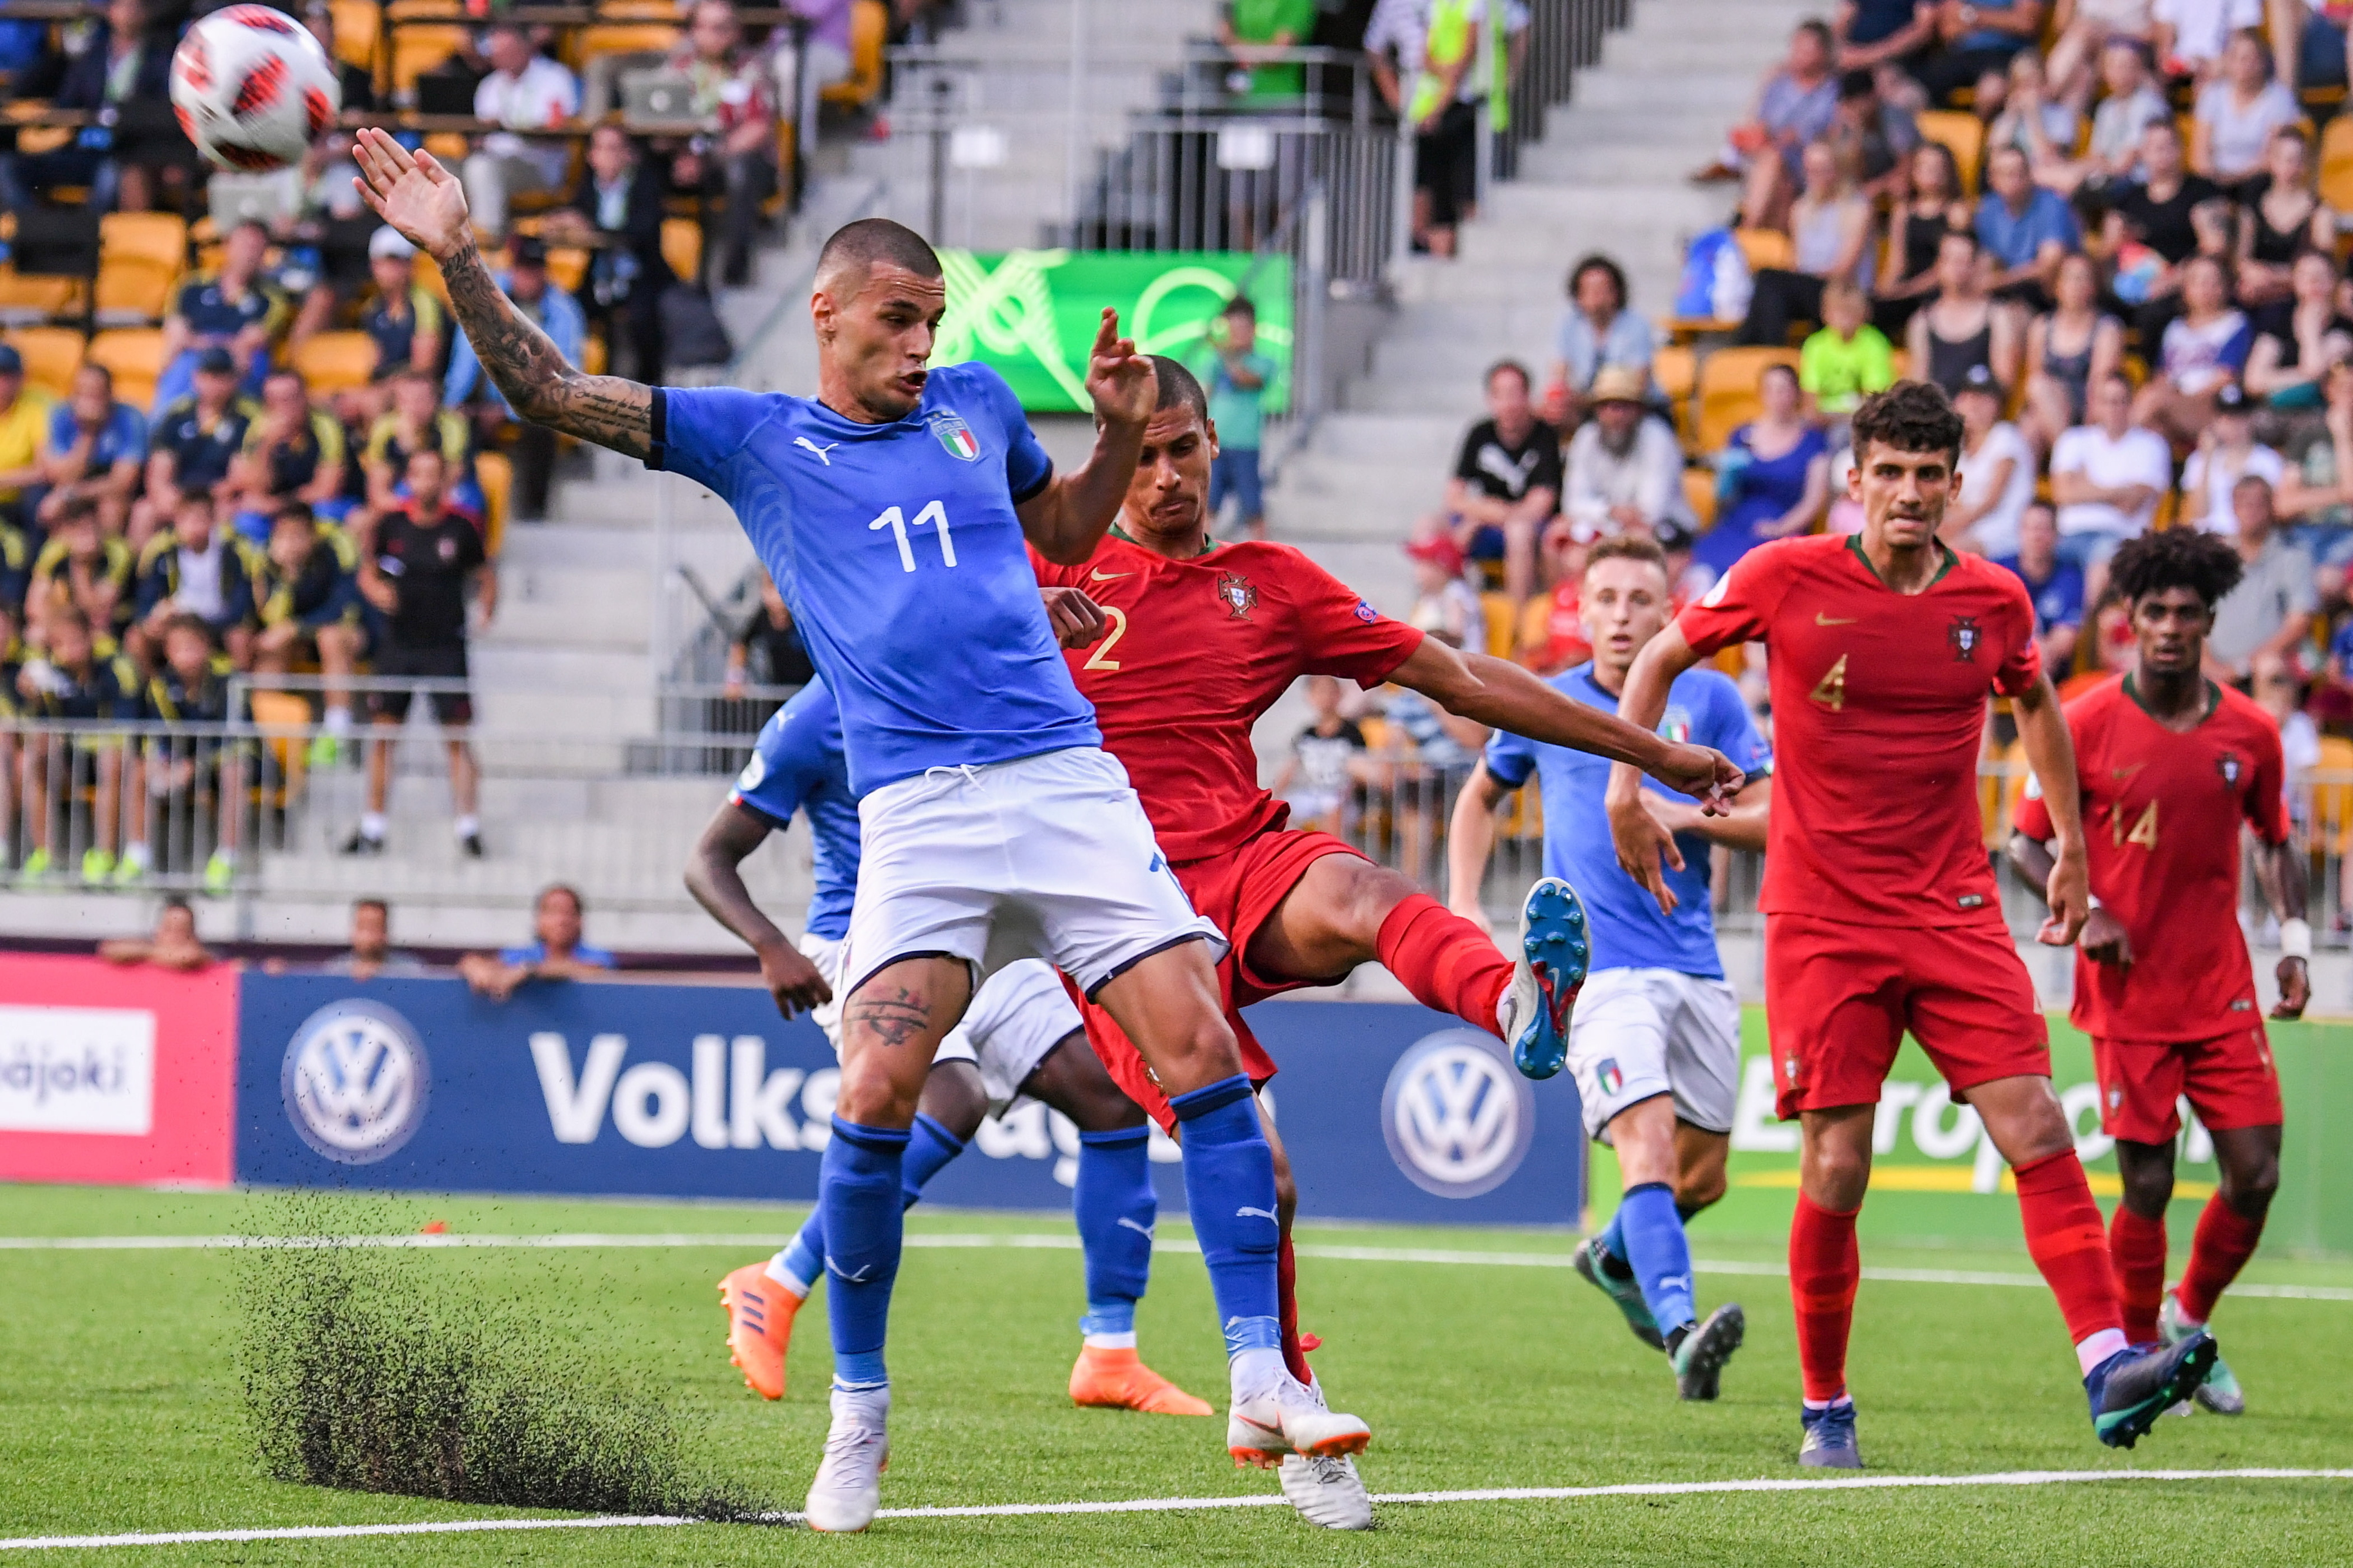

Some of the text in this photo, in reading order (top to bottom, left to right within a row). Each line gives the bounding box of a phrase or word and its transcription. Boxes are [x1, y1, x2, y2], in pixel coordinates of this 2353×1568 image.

[868, 501, 957, 572] 11
[1083, 606, 1126, 670] 2
[1810, 653, 1848, 712] 4
